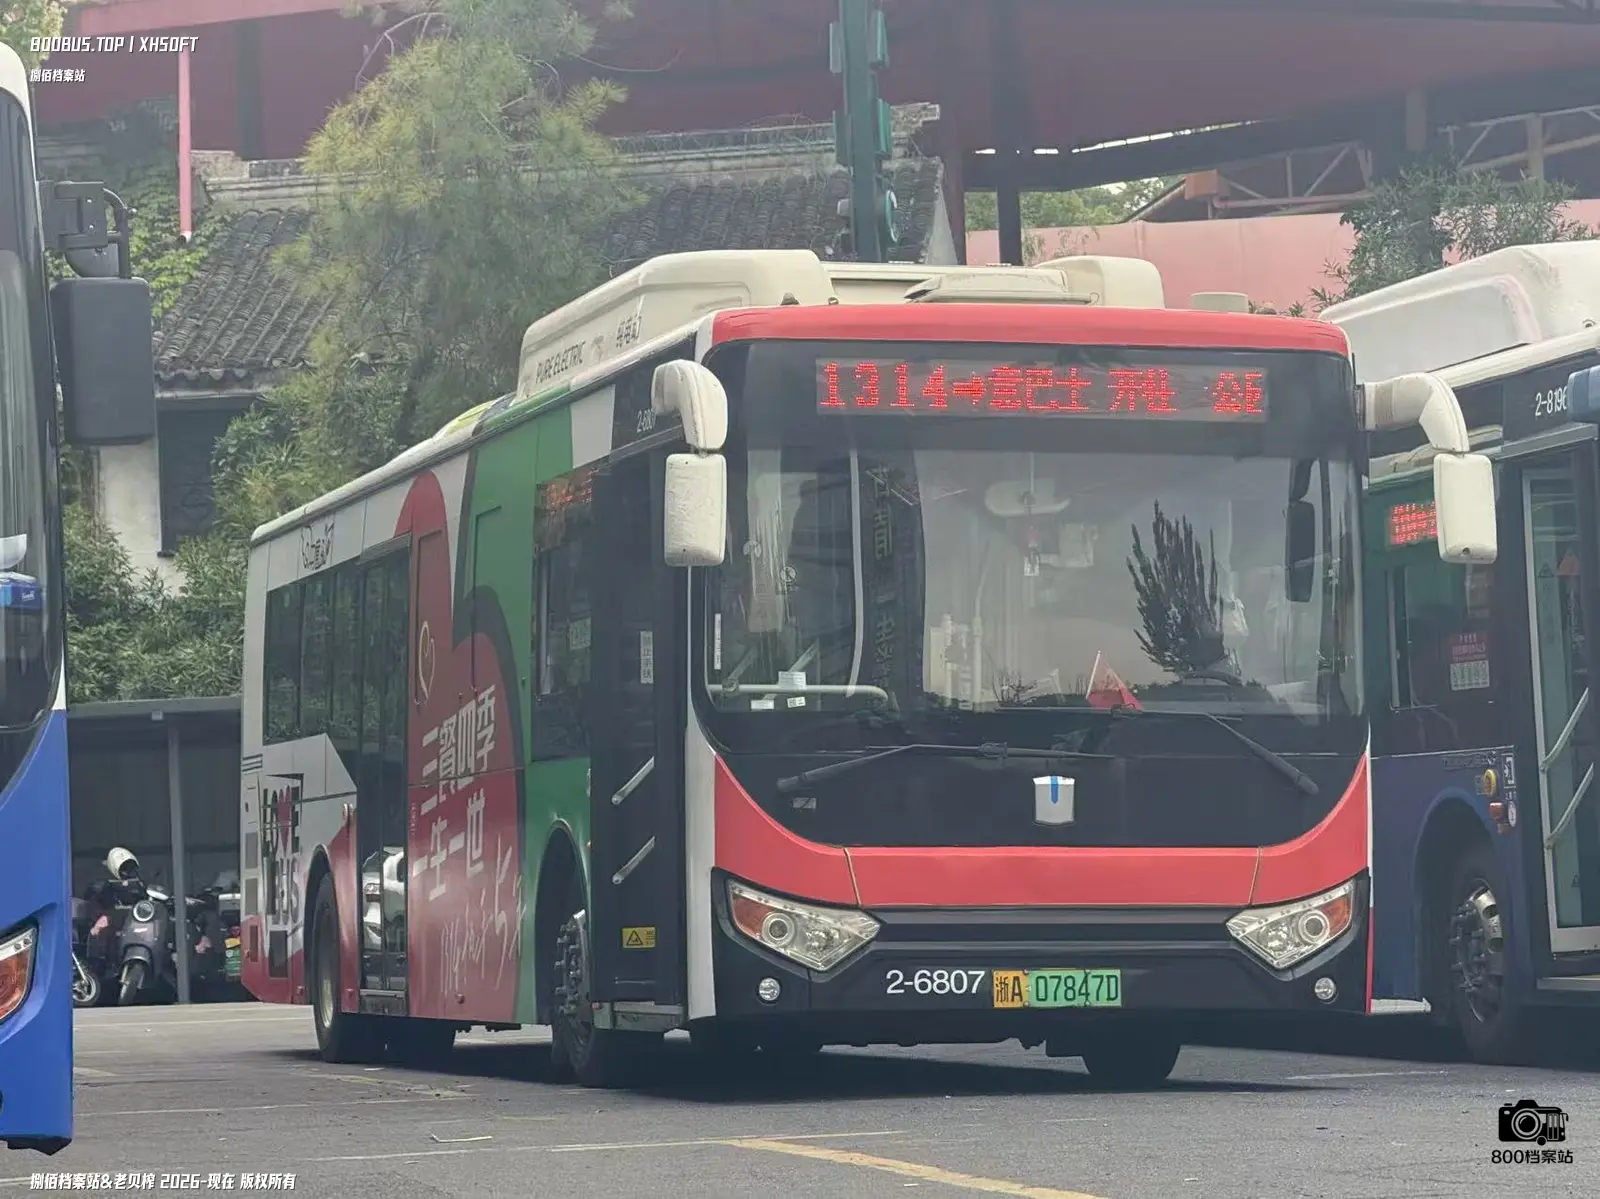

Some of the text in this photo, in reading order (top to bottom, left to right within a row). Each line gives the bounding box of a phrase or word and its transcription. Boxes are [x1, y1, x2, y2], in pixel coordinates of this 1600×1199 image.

[553, 341, 586, 376] ELECTRIC
[820, 361, 948, 409] 1314
[413, 788, 485, 901] 一生一世
[886, 969, 985, 995] 2-6807
